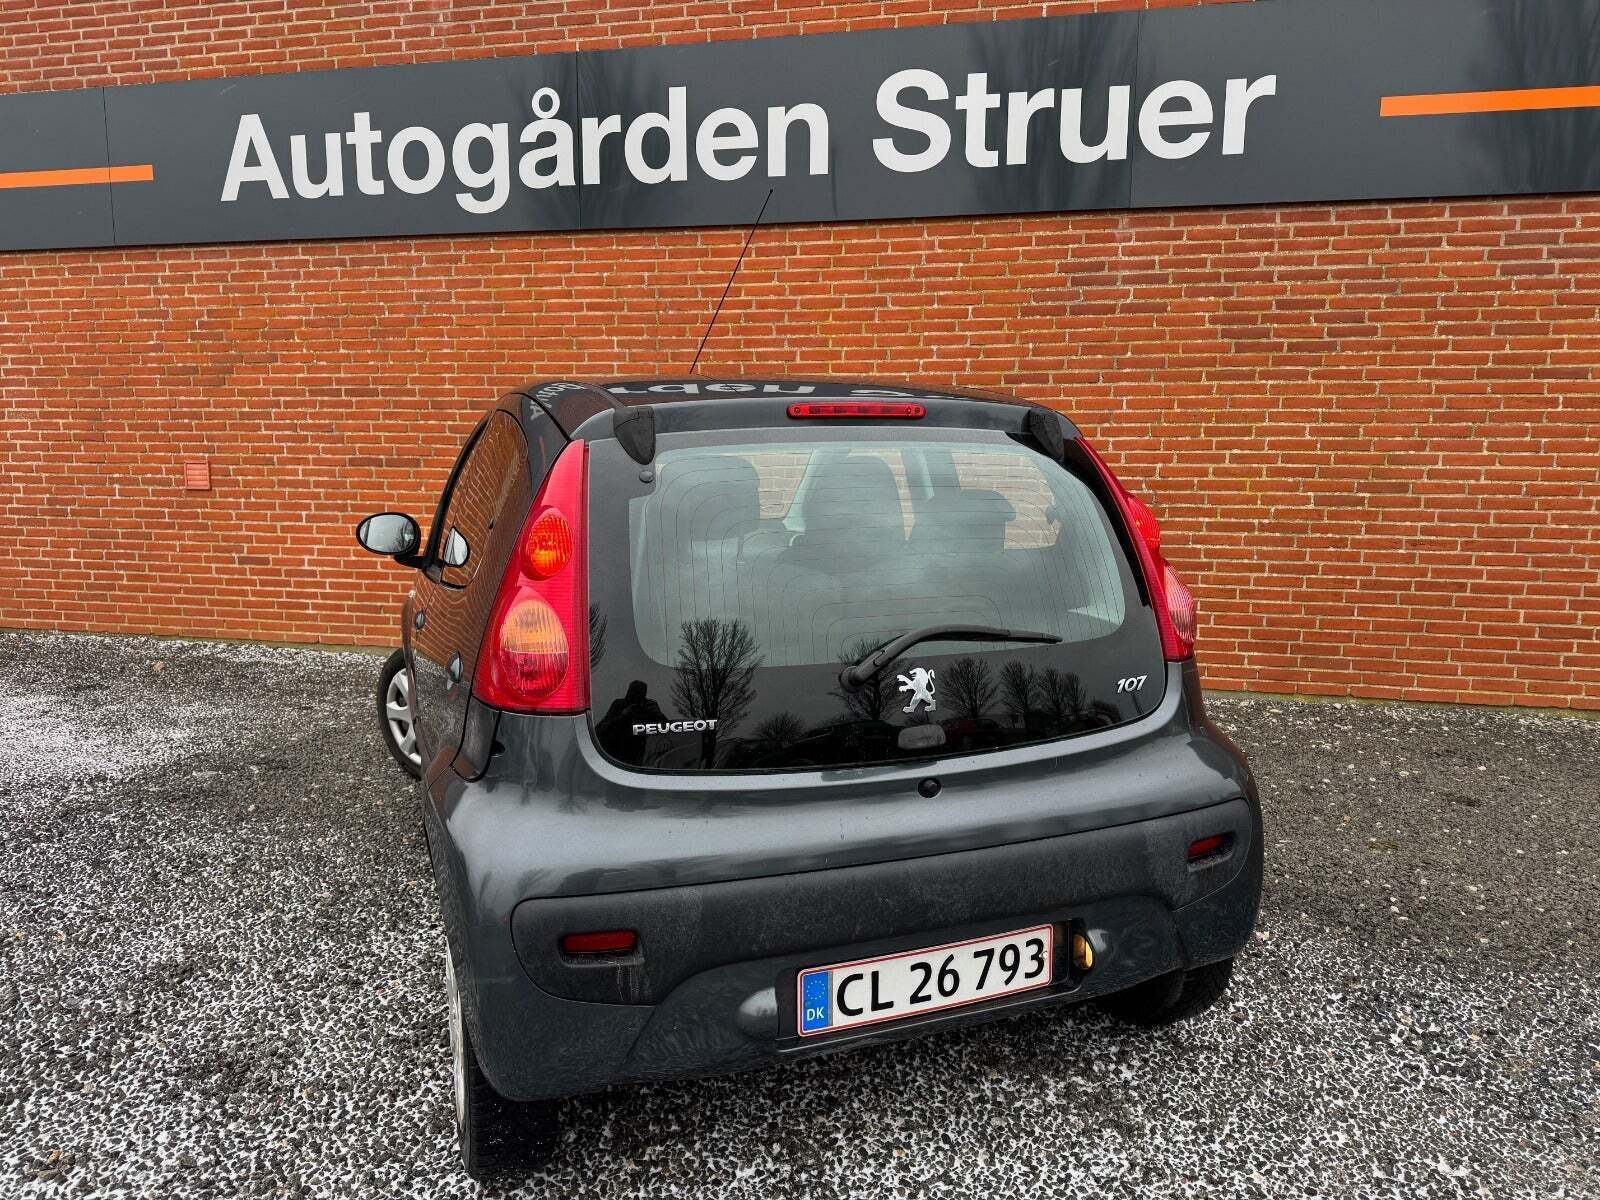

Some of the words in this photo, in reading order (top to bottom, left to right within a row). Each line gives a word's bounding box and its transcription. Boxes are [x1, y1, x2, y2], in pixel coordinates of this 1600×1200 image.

[220, 85, 829, 214] Autogården
[872, 68, 1277, 173] Struer
[1116, 674, 1148, 694] 107
[632, 719, 719, 736] PEUGEOT
[836, 970, 895, 1017] CL
[909, 954, 960, 1005] 26
[973, 937, 1045, 991] 793
[806, 1006, 825, 1022] DK
